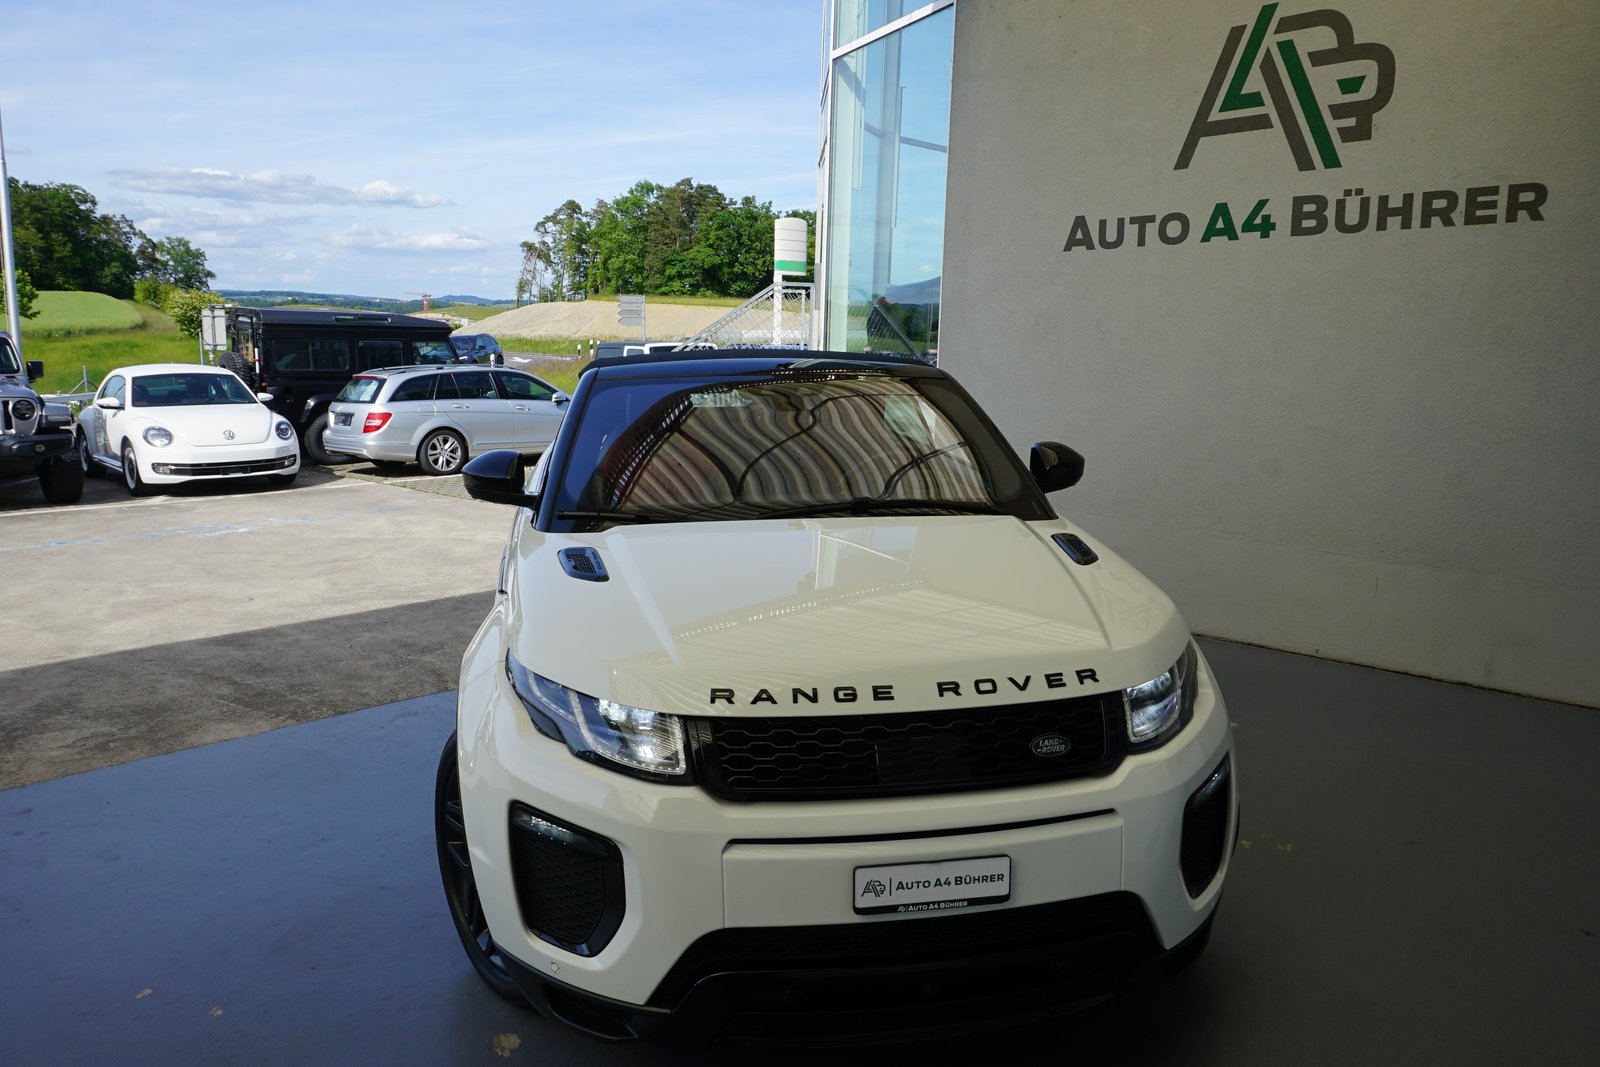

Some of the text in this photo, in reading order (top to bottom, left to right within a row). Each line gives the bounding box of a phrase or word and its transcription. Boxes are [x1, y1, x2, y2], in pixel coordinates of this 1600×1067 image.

[1063, 182, 1549, 252] AUTO A4 BÜHRER
[709, 667, 1100, 705] RANGE ROVER
[896, 880, 932, 891] AUTO
[934, 876, 952, 888] A4
[954, 873, 1005, 886] BÜHRER
[908, 904, 928, 912] AUTO
[928, 902, 939, 910] A4
[940, 900, 968, 909] BÜHRER
